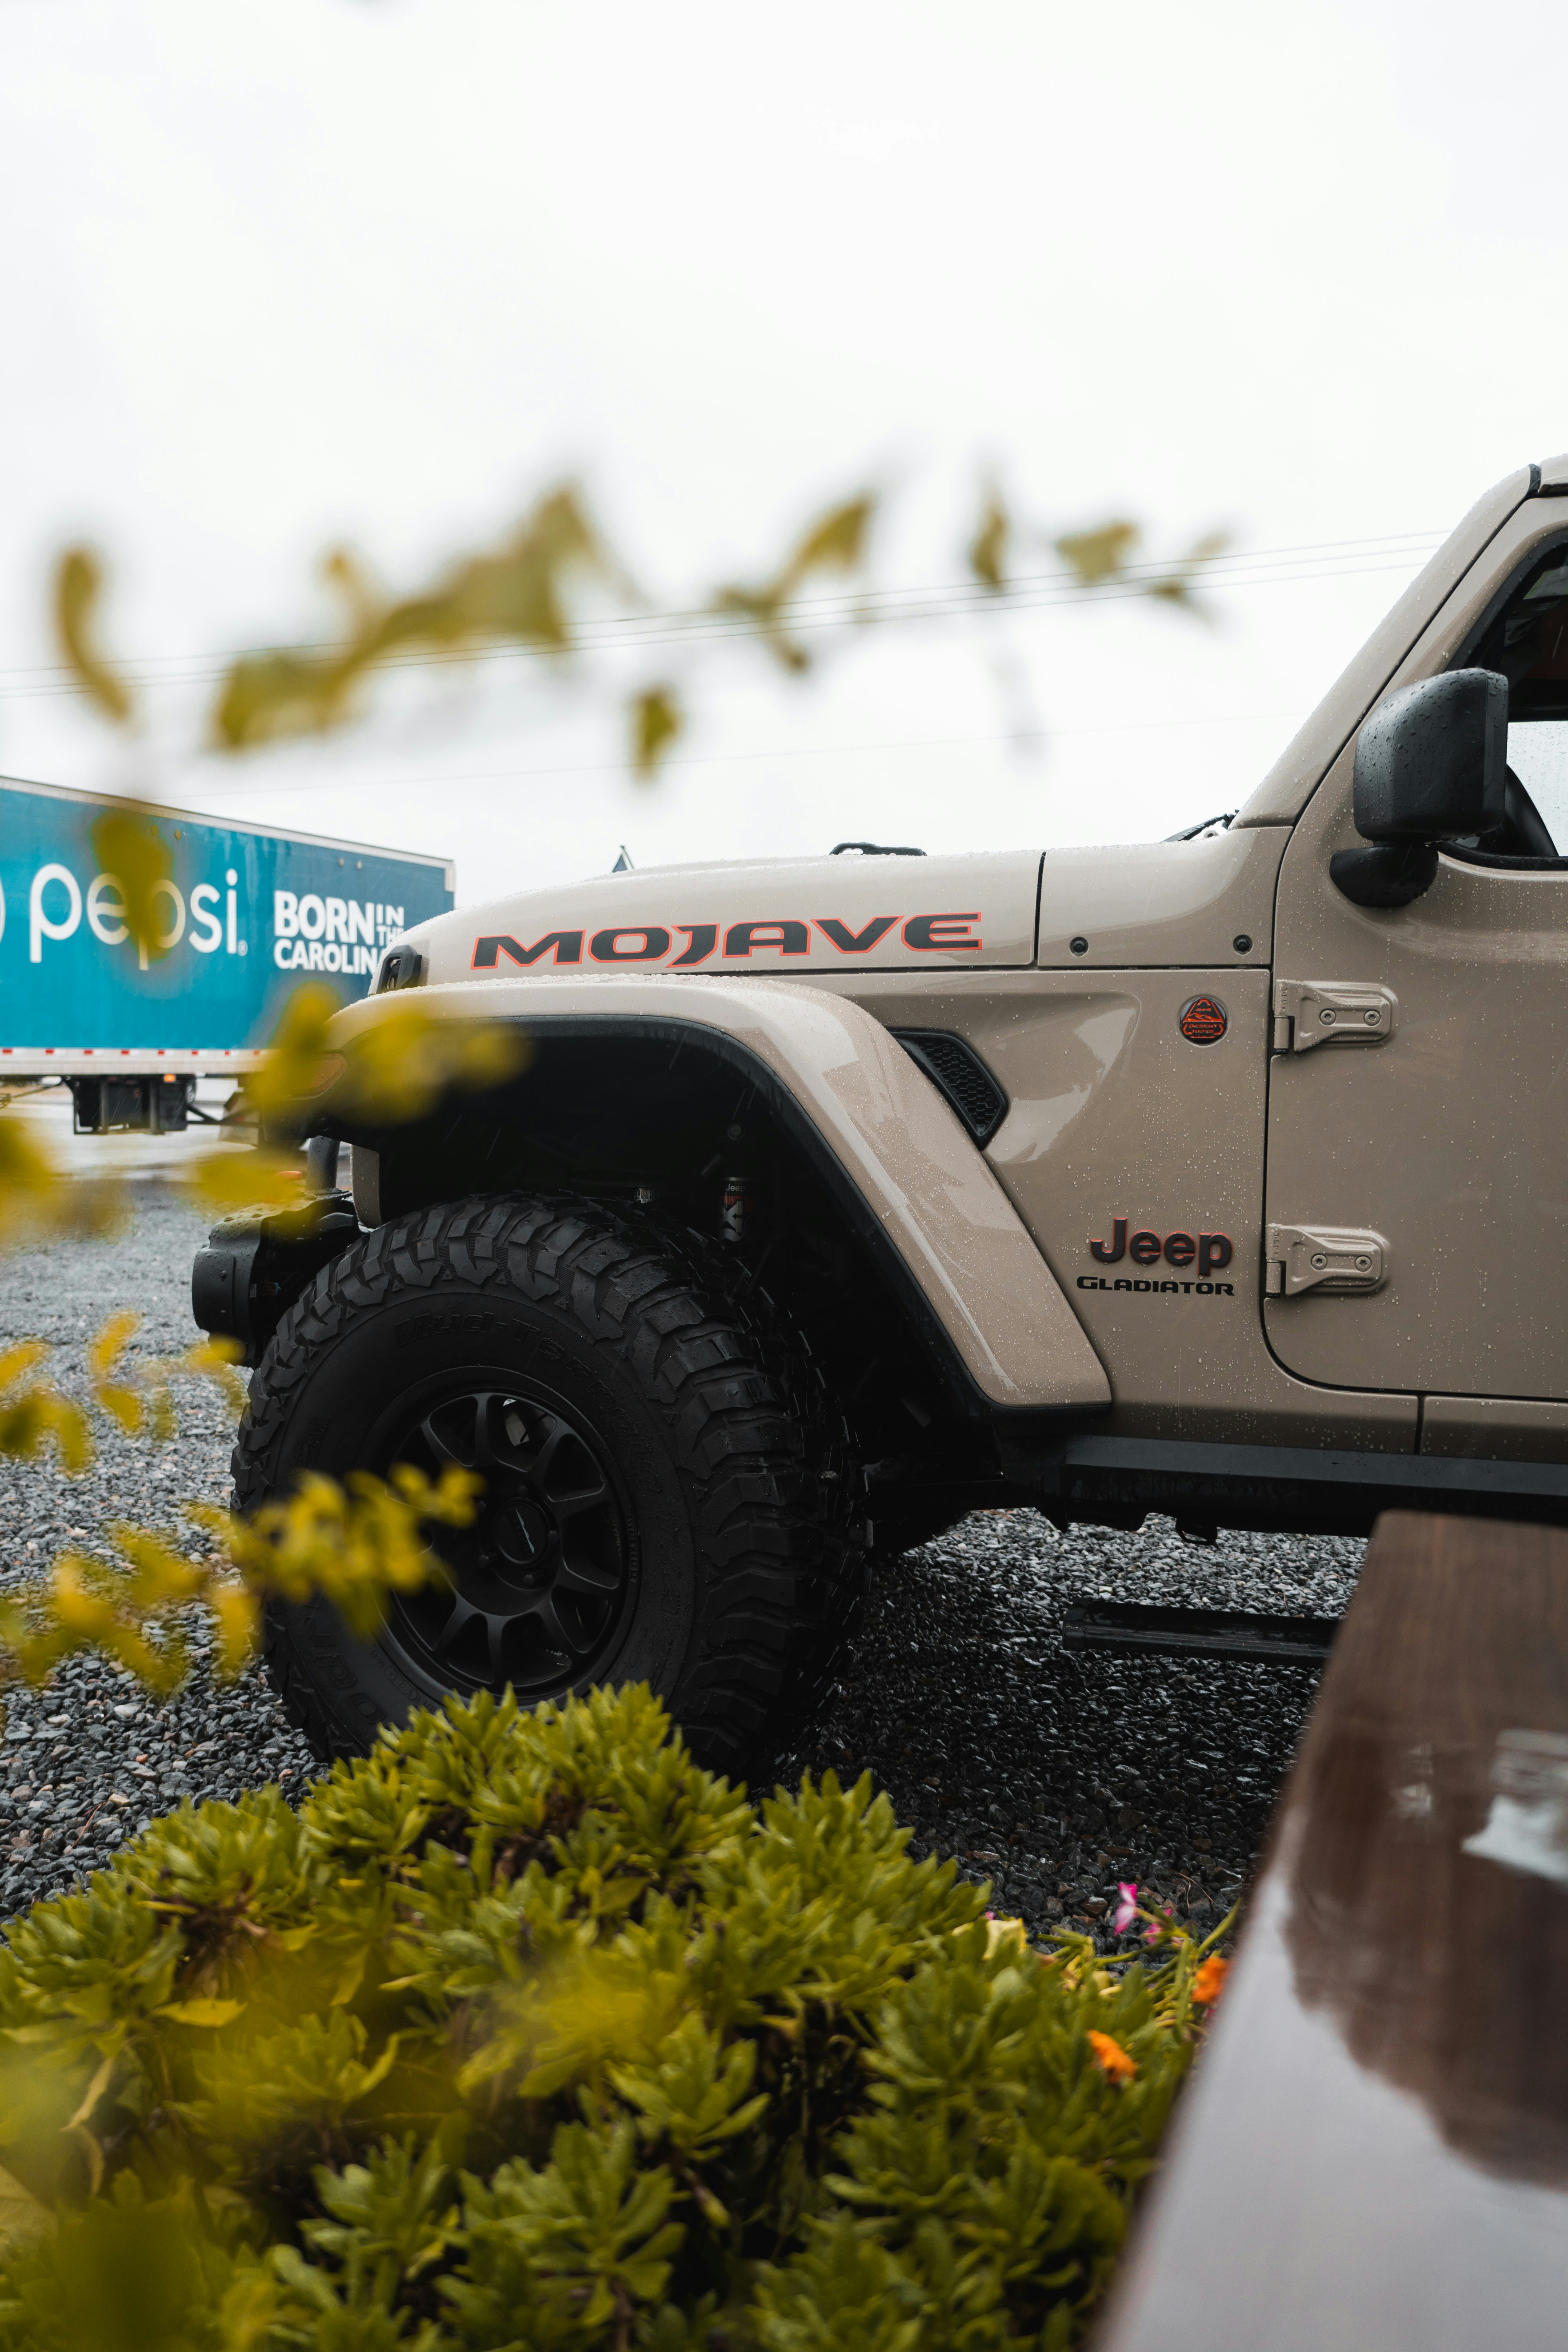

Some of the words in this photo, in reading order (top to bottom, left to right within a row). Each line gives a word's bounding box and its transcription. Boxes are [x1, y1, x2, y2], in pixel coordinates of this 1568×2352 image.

[29, 863, 238, 971] pepsi
[275, 890, 375, 946] BORN
[376, 904, 404, 926] IN
[376, 925, 404, 947] TH
[471, 912, 982, 969] MOJAVE
[275, 938, 386, 975] CAROLIN
[725, 1183, 746, 1193] Jeep
[1090, 1217, 1233, 1276] Jeep
[1077, 1276, 1235, 1296] GLADIATOR
